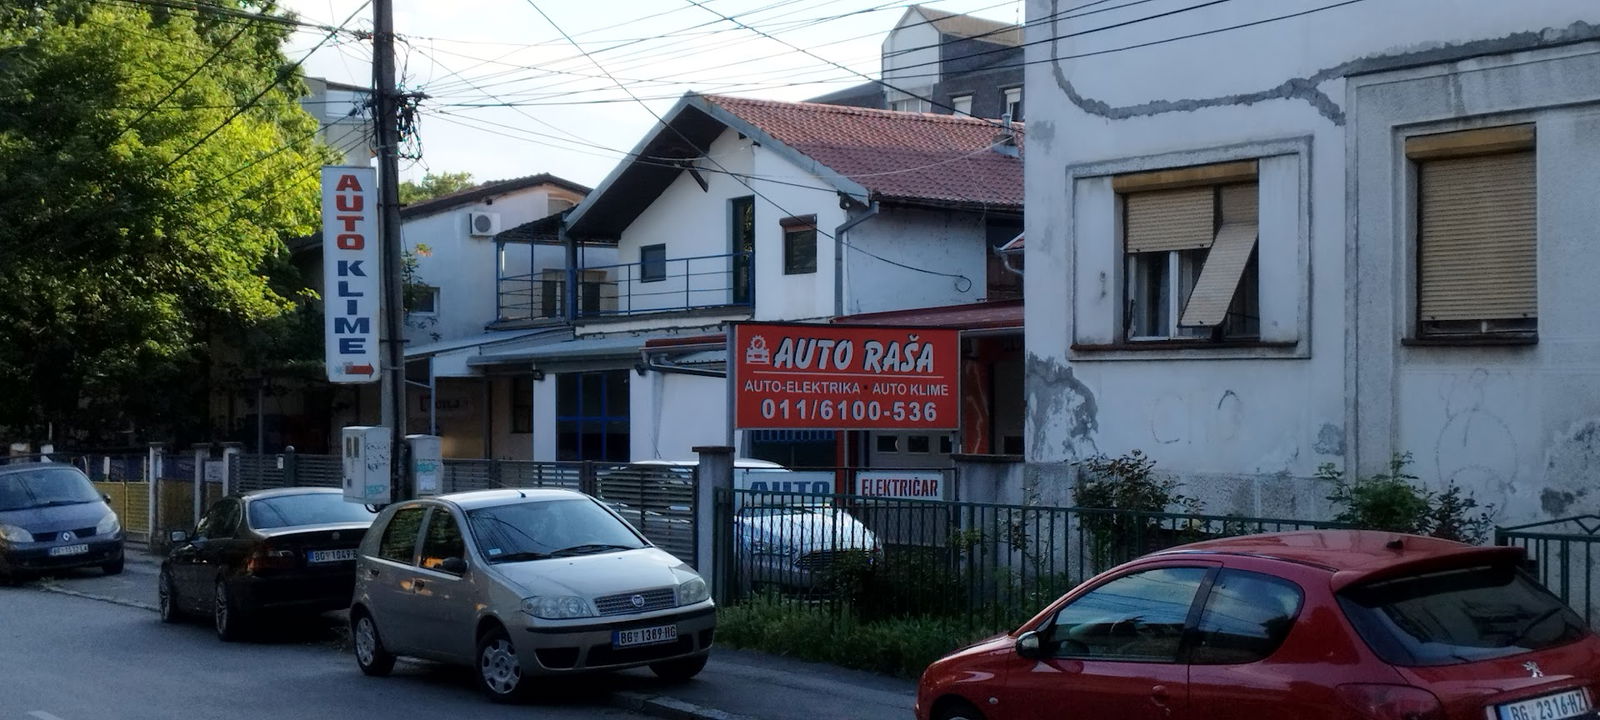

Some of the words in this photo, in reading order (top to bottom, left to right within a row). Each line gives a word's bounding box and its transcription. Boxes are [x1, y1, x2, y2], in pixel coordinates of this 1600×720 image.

[336, 174, 365, 251] AUTO
[334, 260, 370, 355] KLIME
[773, 336, 854, 371] AUTO
[863, 334, 935, 374] RAŠA
[744, 380, 861, 394] AUTO-ELEKTRIKA
[872, 382, 907, 395] AUTO
[909, 384, 949, 396] KLIME
[761, 399, 936, 421] 011/6100-536
[750, 481, 830, 496] AUTO
[861, 476, 938, 497] ELEKTRIČAR
[620, 631, 633, 644] BG
[1536, 693, 1584, 719] 2316-HZ
